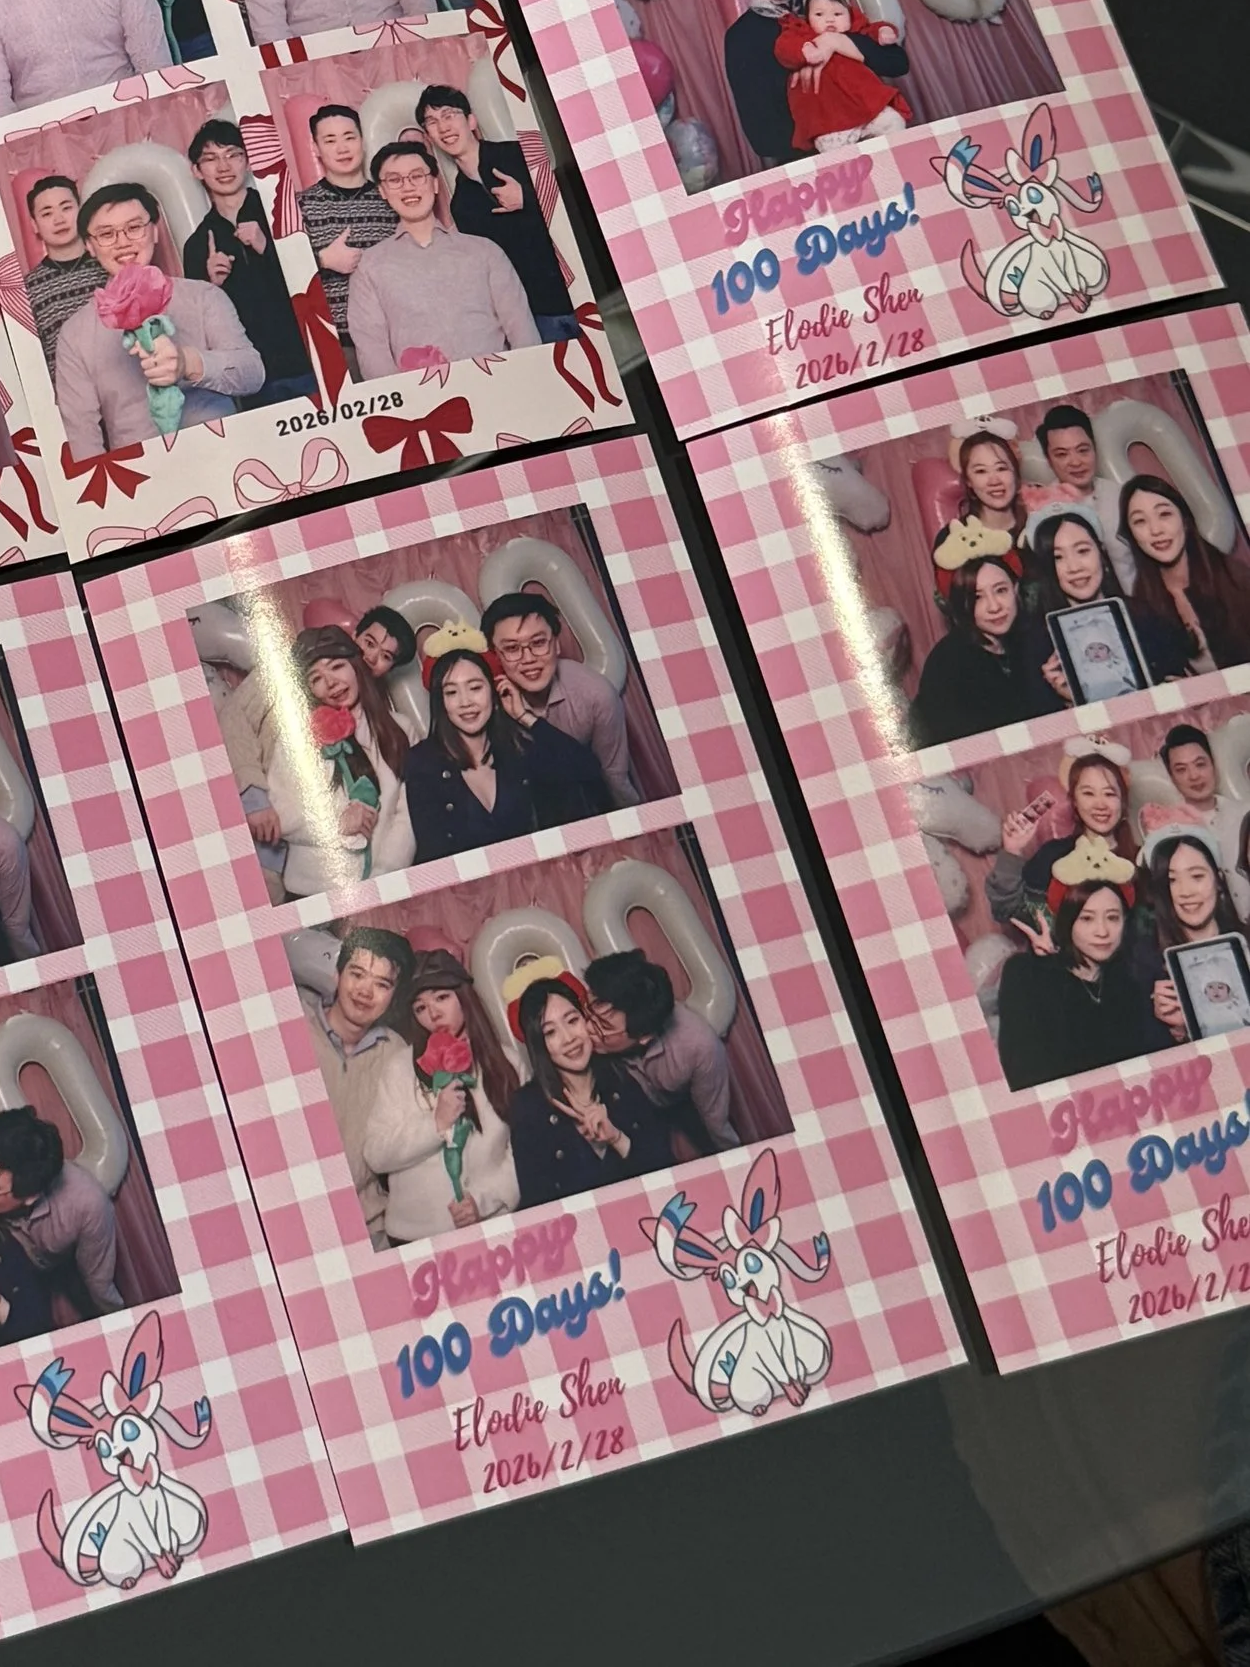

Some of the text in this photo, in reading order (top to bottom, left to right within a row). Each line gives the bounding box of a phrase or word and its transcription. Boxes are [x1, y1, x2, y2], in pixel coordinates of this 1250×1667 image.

[723, 154, 873, 246] Happy
[711, 181, 919, 315] 100 Days!
[765, 272, 924, 356] Elodie Shen
[795, 329, 925, 390] 2026/2/28
[276, 391, 404, 437] 2026/02/28
[1050, 1054, 1213, 1156] Happy
[1037, 1159, 1113, 1234] 100
[1097, 1193, 1250, 1284] Elodie She
[410, 1213, 578, 1318] Happy
[1129, 1261, 1250, 1324] 2026/2/2
[396, 1248, 626, 1399] 100 Days!
[452, 1357, 626, 1452] Elodie Shen
[483, 1426, 625, 1495] 2026/2/28
